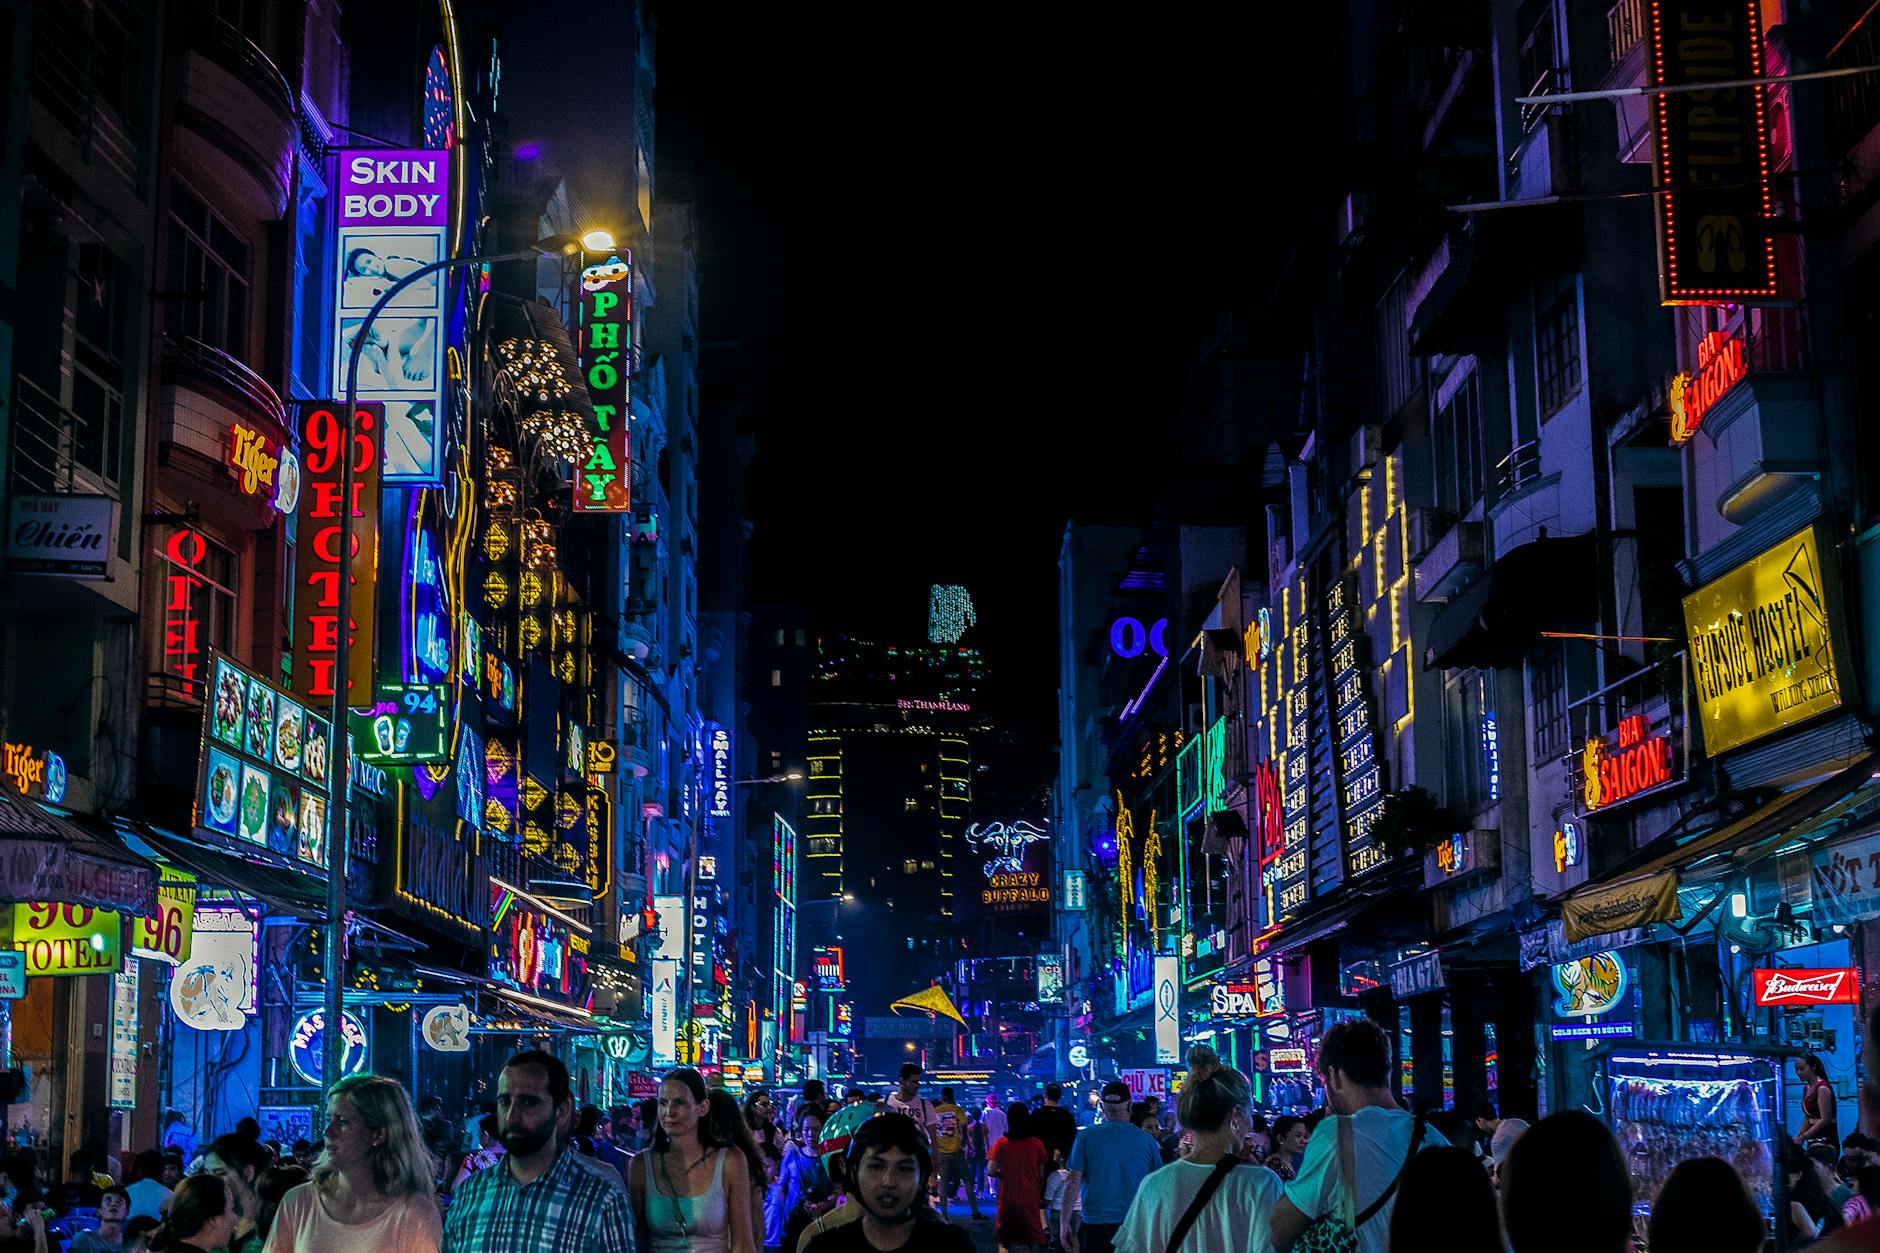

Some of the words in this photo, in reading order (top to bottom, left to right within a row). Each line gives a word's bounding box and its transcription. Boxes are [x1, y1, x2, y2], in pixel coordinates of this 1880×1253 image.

[350, 157, 436, 185] SKIN
[343, 193, 441, 219] BODY
[1698, 332, 1716, 369] BIA
[232, 423, 278, 495] Tiger
[15, 520, 102, 550] Chiến
[404, 691, 437, 715] 94
[1619, 715, 1641, 748] BIA
[990, 872, 1040, 888] CRAZY
[982, 888, 1051, 904] BUFFALO
[143, 902, 184, 958] 96
[693, 896, 708, 984] HOTEL
[1212, 985, 1258, 1014] SPA
[1766, 978, 1838, 994] Budweiser
[1148, 1073, 1166, 1093] XE
